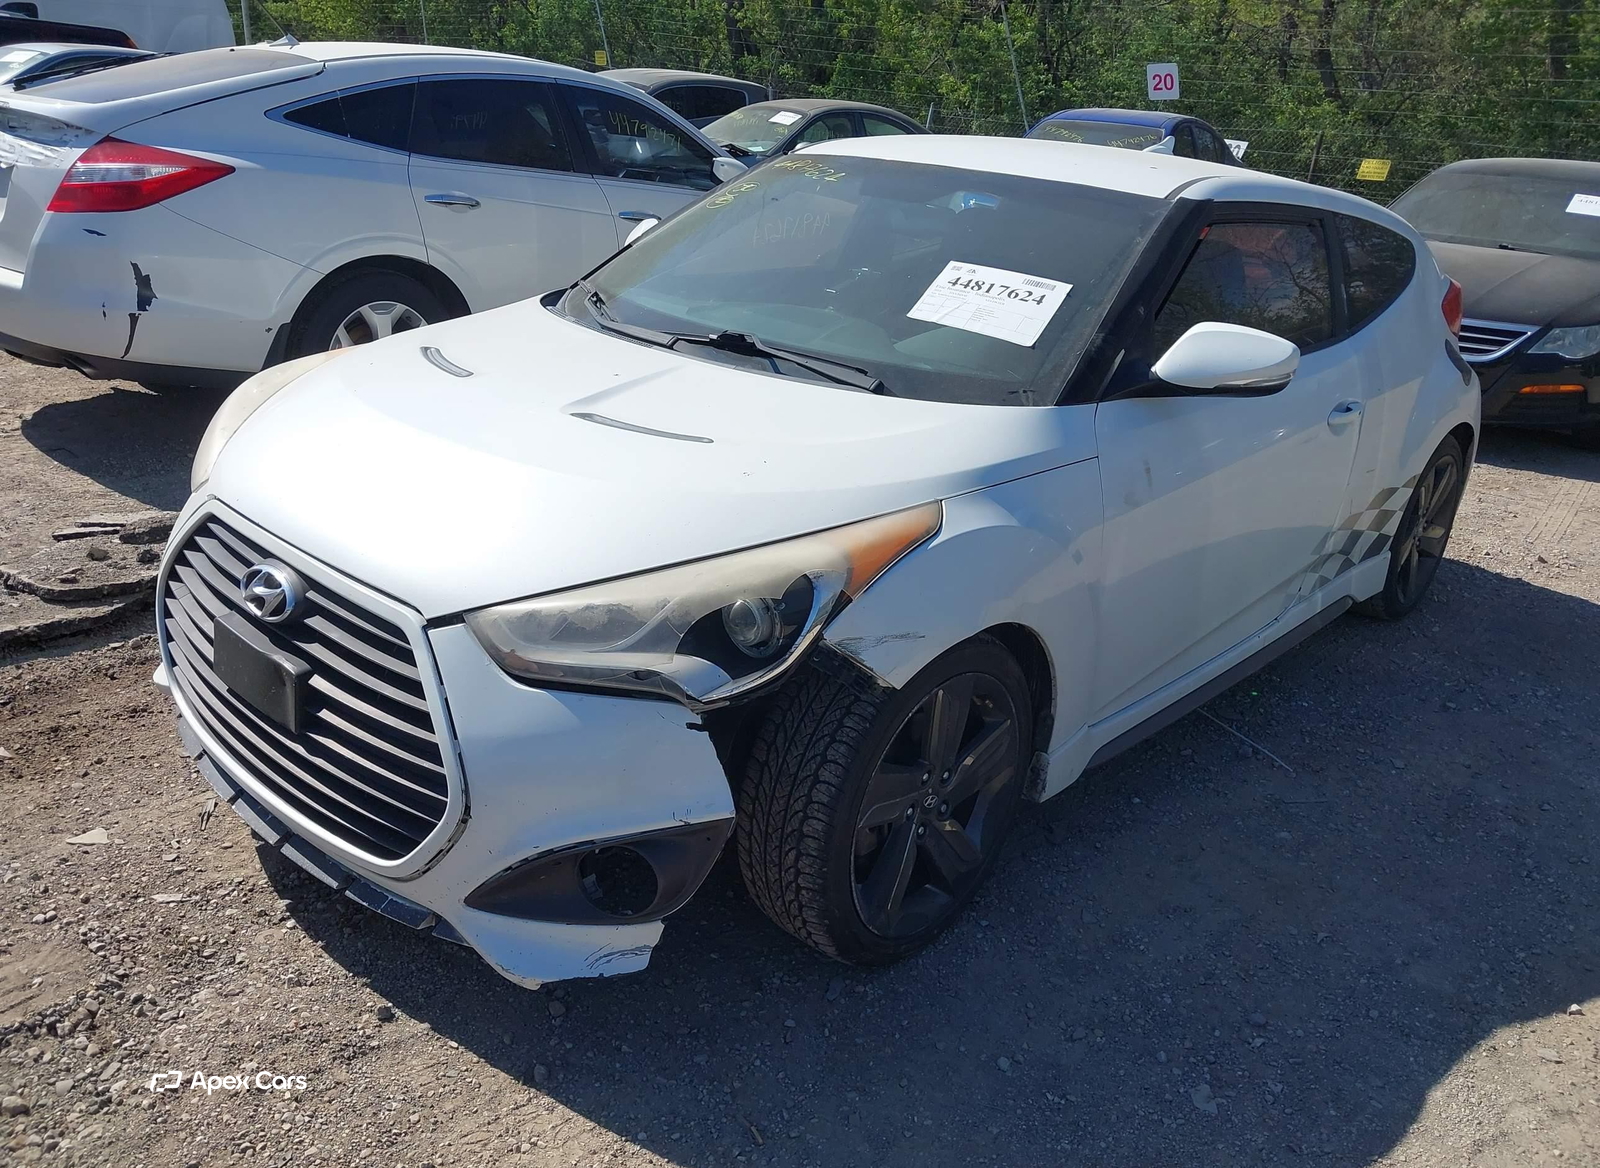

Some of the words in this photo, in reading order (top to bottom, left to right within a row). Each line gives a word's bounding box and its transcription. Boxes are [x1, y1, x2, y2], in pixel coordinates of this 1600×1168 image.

[1151, 73, 1174, 91] 20
[608, 110, 682, 152] 44792471
[947, 276, 1047, 306] 44817624
